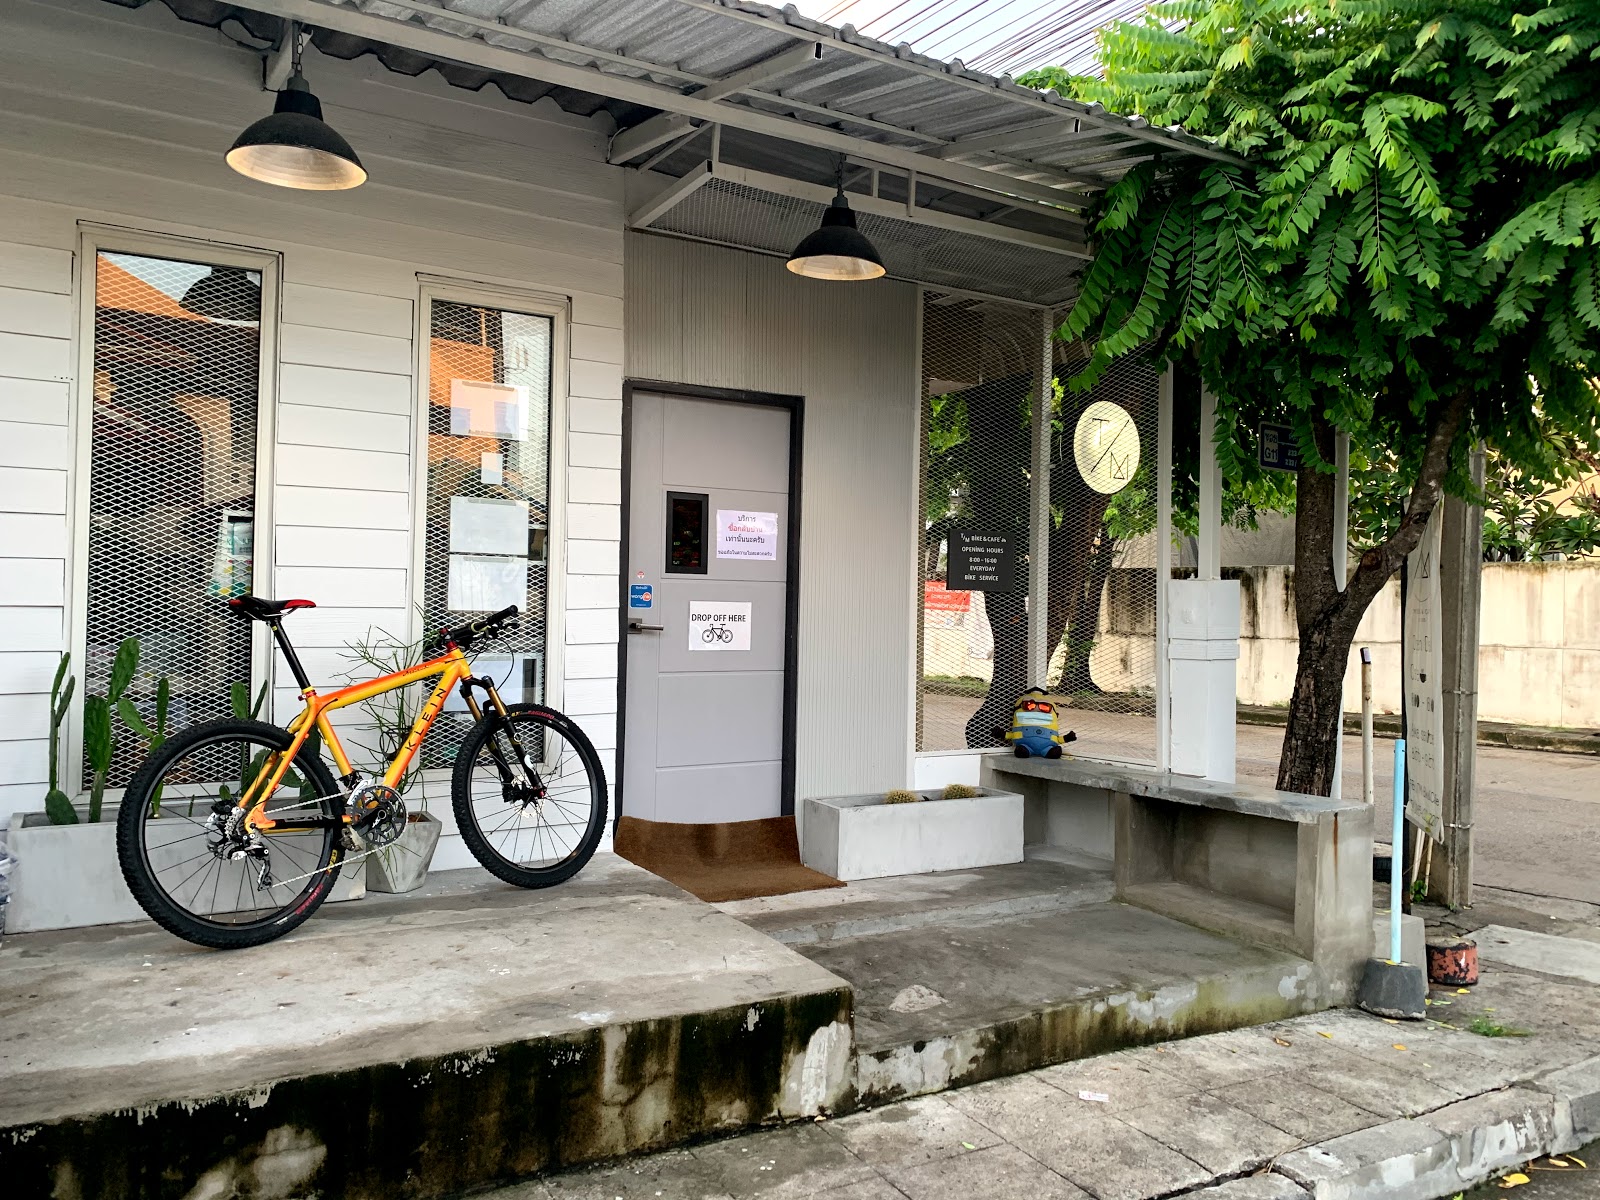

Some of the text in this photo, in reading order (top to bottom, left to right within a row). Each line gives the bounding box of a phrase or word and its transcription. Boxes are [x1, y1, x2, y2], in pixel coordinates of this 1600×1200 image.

[737, 514, 756, 522] บริการ
[691, 613, 747, 622] DROP OFF HERE
[404, 687, 447, 752] KLEIN
